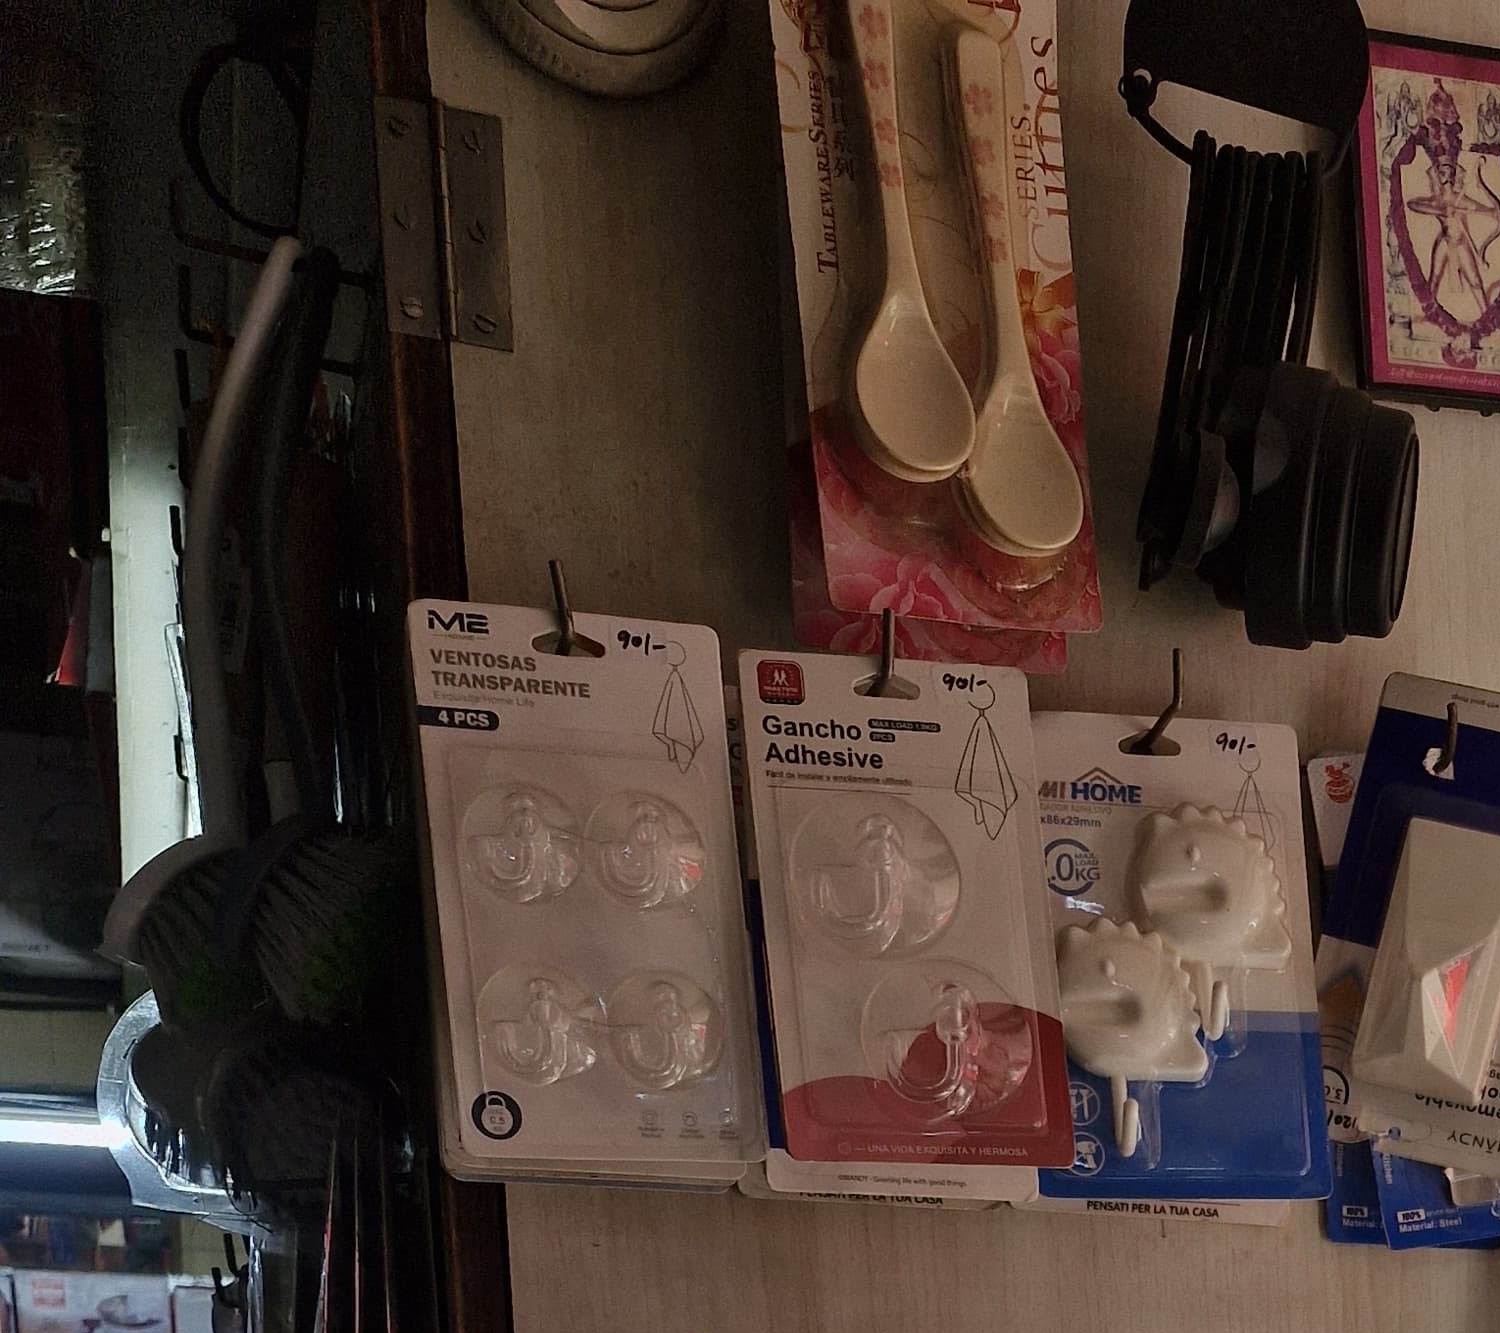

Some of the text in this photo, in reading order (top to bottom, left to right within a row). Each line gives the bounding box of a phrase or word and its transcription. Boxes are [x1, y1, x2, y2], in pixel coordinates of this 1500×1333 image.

[617, 630, 667, 656] 90/-
[430, 648, 537, 671] VENTOSAS
[431, 670, 591, 698] TRANSPARENTE
[942, 672, 987, 693] 90/-
[454, 711, 490, 728] PCS
[761, 714, 862, 741] Gancho
[1215, 733, 1257, 754] 90/-
[765, 742, 884, 769] Adhesive
[1070, 782, 1142, 803] HOME
[1086, 1200, 1219, 1218] PENSATI PER LA TUA CASA
